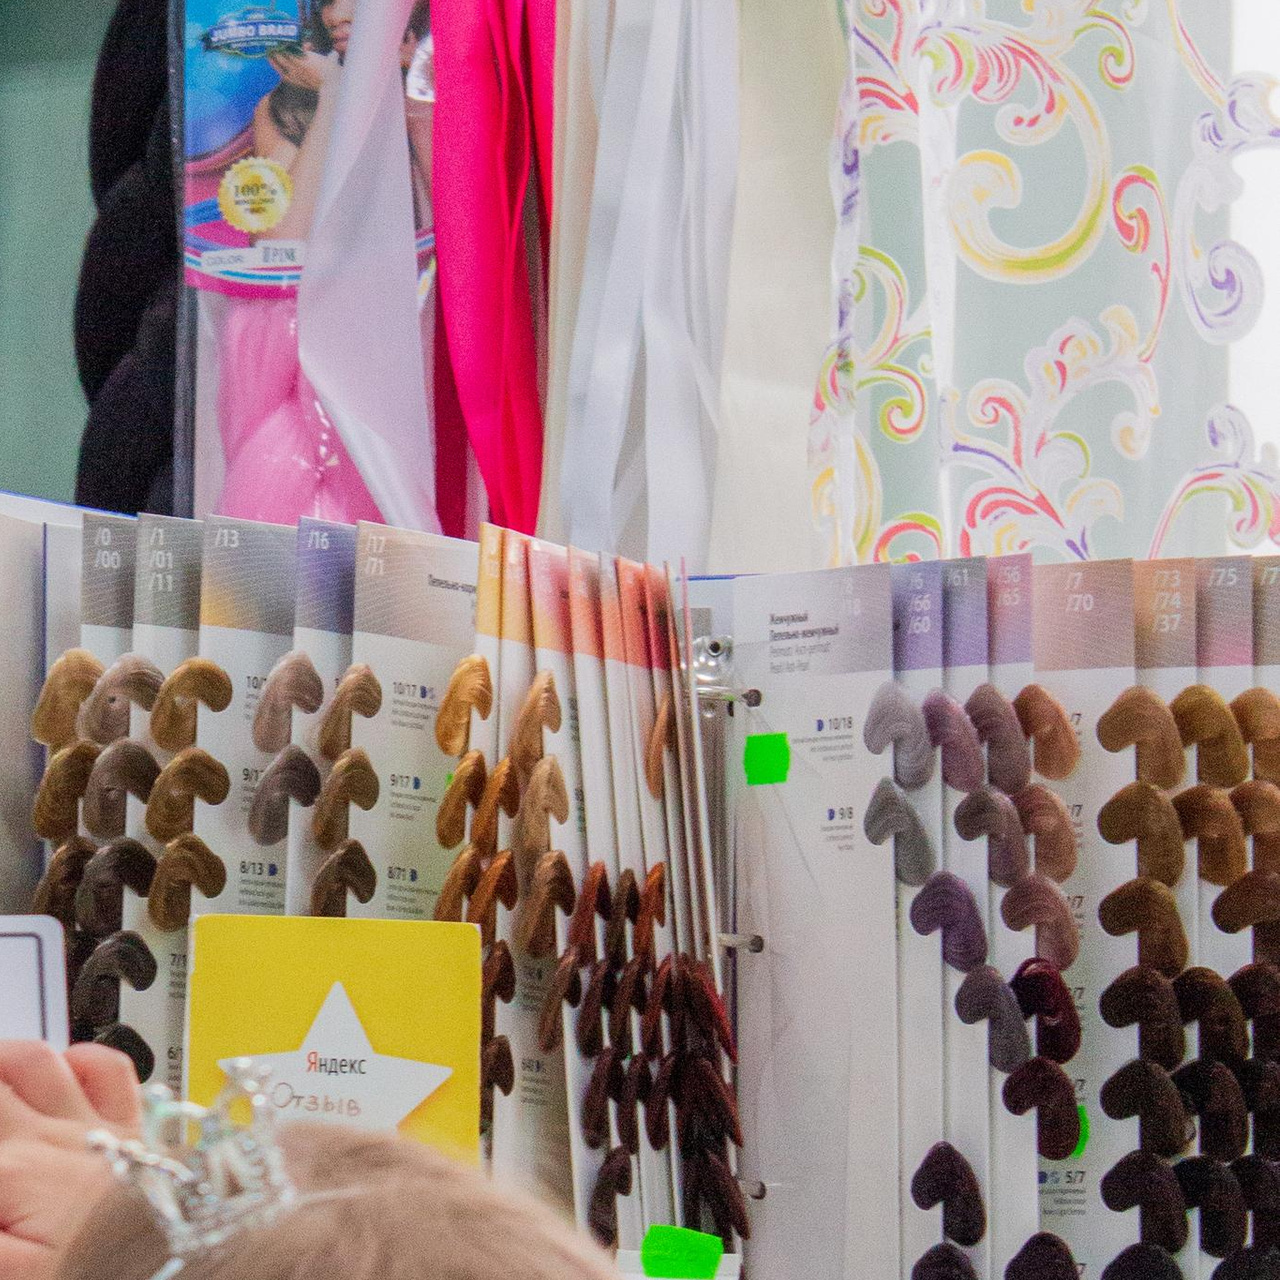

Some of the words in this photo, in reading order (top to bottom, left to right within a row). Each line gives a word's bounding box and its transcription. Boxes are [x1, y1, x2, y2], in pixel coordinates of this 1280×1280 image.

[215, 529, 239, 548] /13
[308, 531, 329, 550] /16
[1207, 568, 1237, 588] /75
[1066, 593, 1094, 613] /70
[390, 774, 410, 788] 9/17
[240, 861, 264, 876] 8/13
[306, 1051, 367, 1075] Яндекс
[271, 1081, 362, 1117] Отзыв
